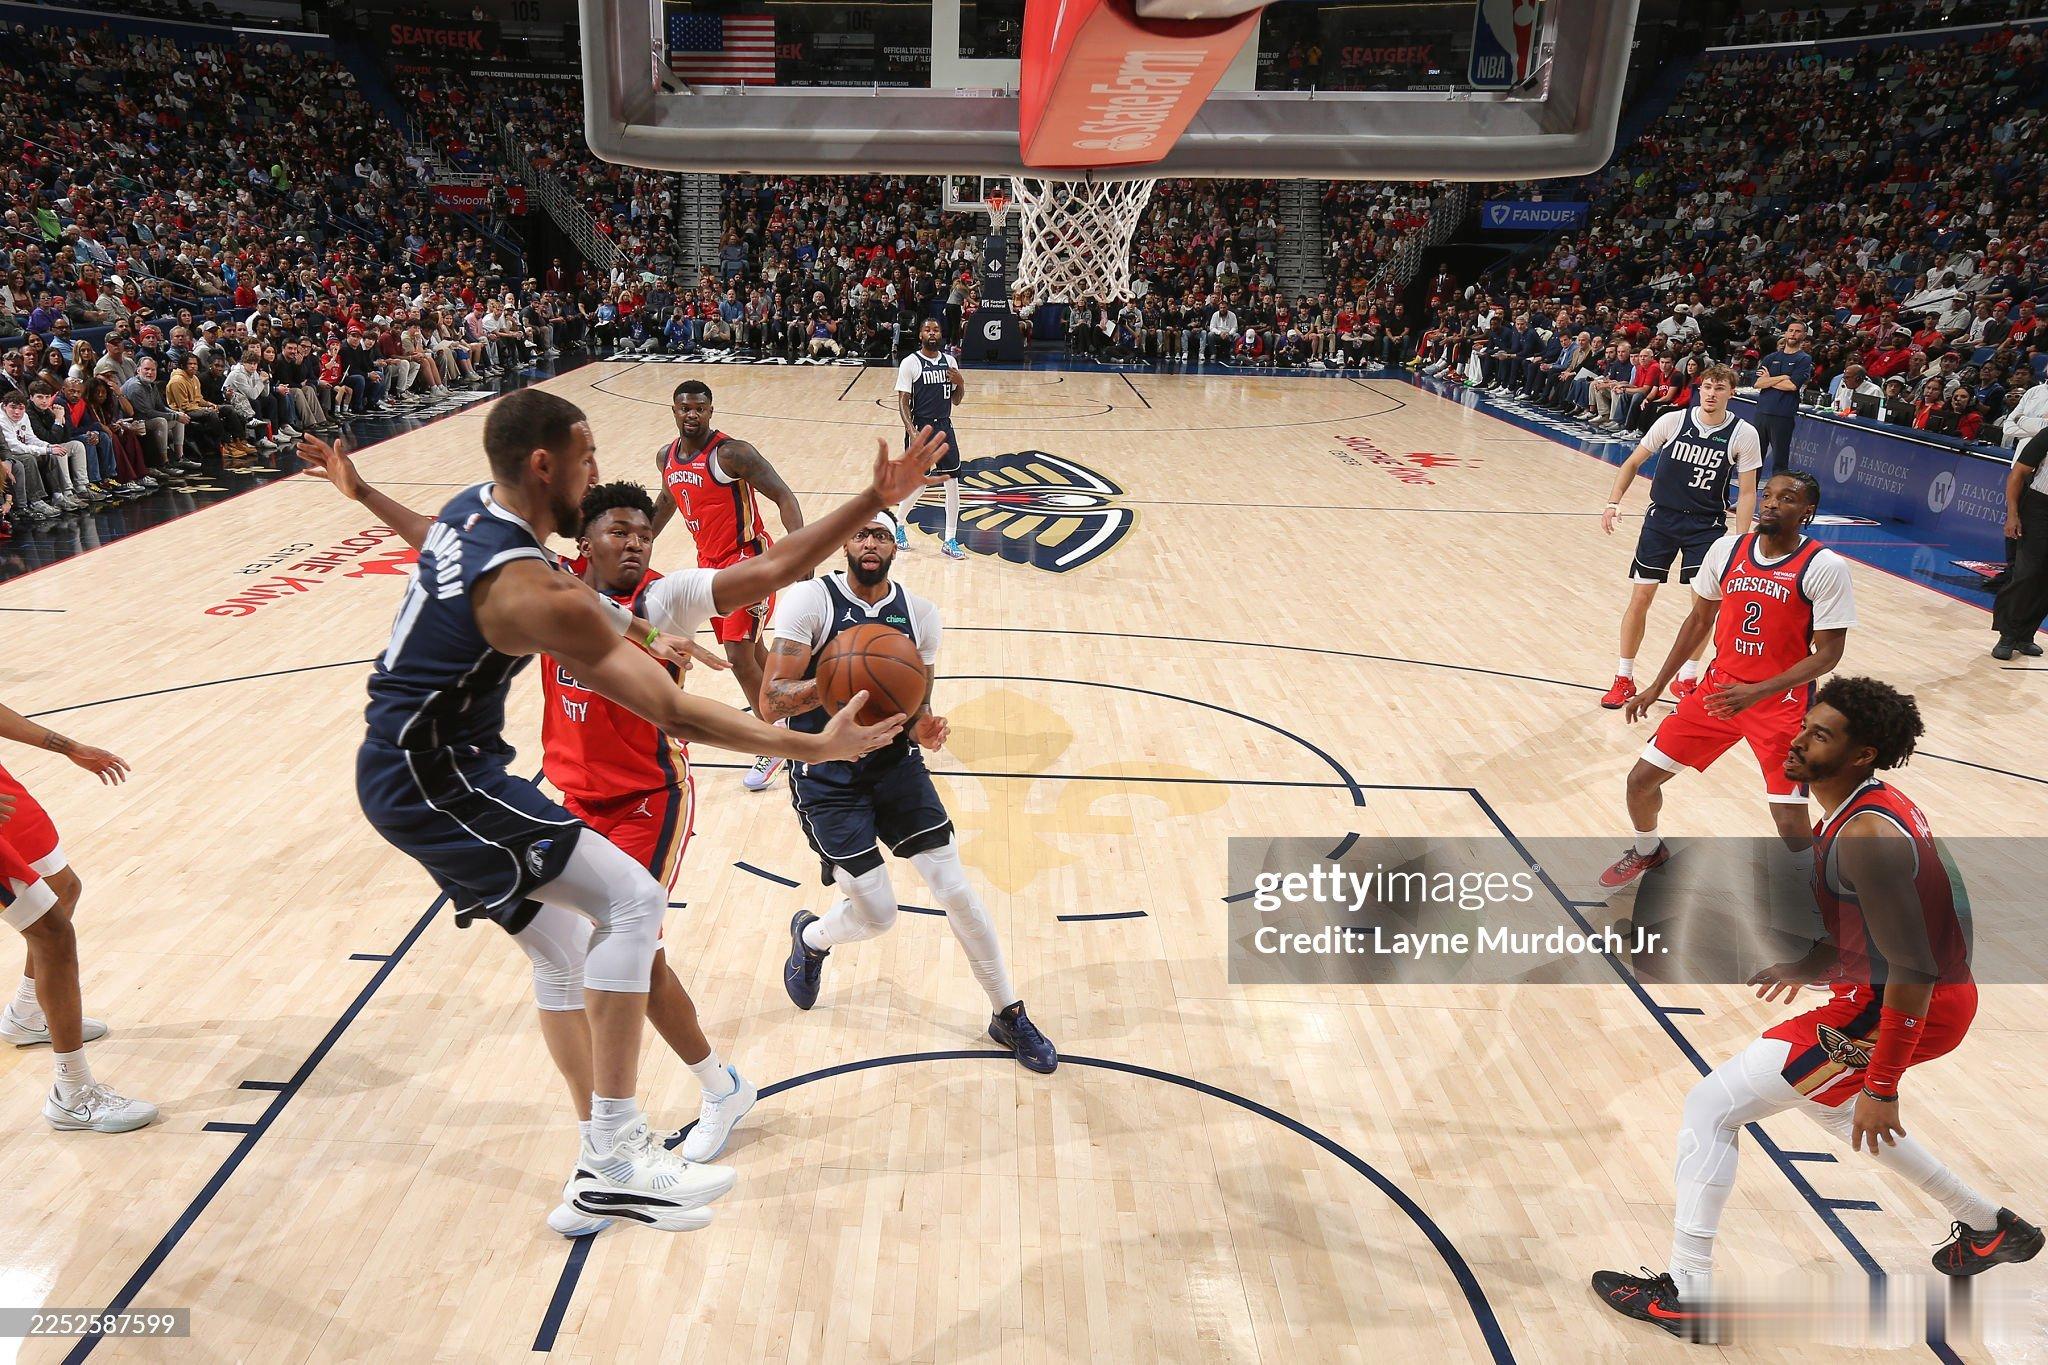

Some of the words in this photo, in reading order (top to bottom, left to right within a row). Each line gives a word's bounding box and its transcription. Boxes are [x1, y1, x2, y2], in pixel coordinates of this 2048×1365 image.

[390, 24, 483, 50] SEATGEEK
[1477, 55, 1506, 79] NBA
[668, 471, 703, 488] CRESCENT
[1688, 467, 1717, 490] 32
[1859, 456, 1910, 480] HANCOCK
[1857, 471, 1905, 495] WHITNEY
[681, 489, 691, 516] 1
[1956, 500, 2006, 525] WHITNE
[233, 542, 314, 576] CENTER
[1727, 577, 1790, 603] CRESCENT
[886, 615, 906, 624] chime
[1743, 601, 1762, 635] 2
[1735, 638, 1764, 656] CITY
